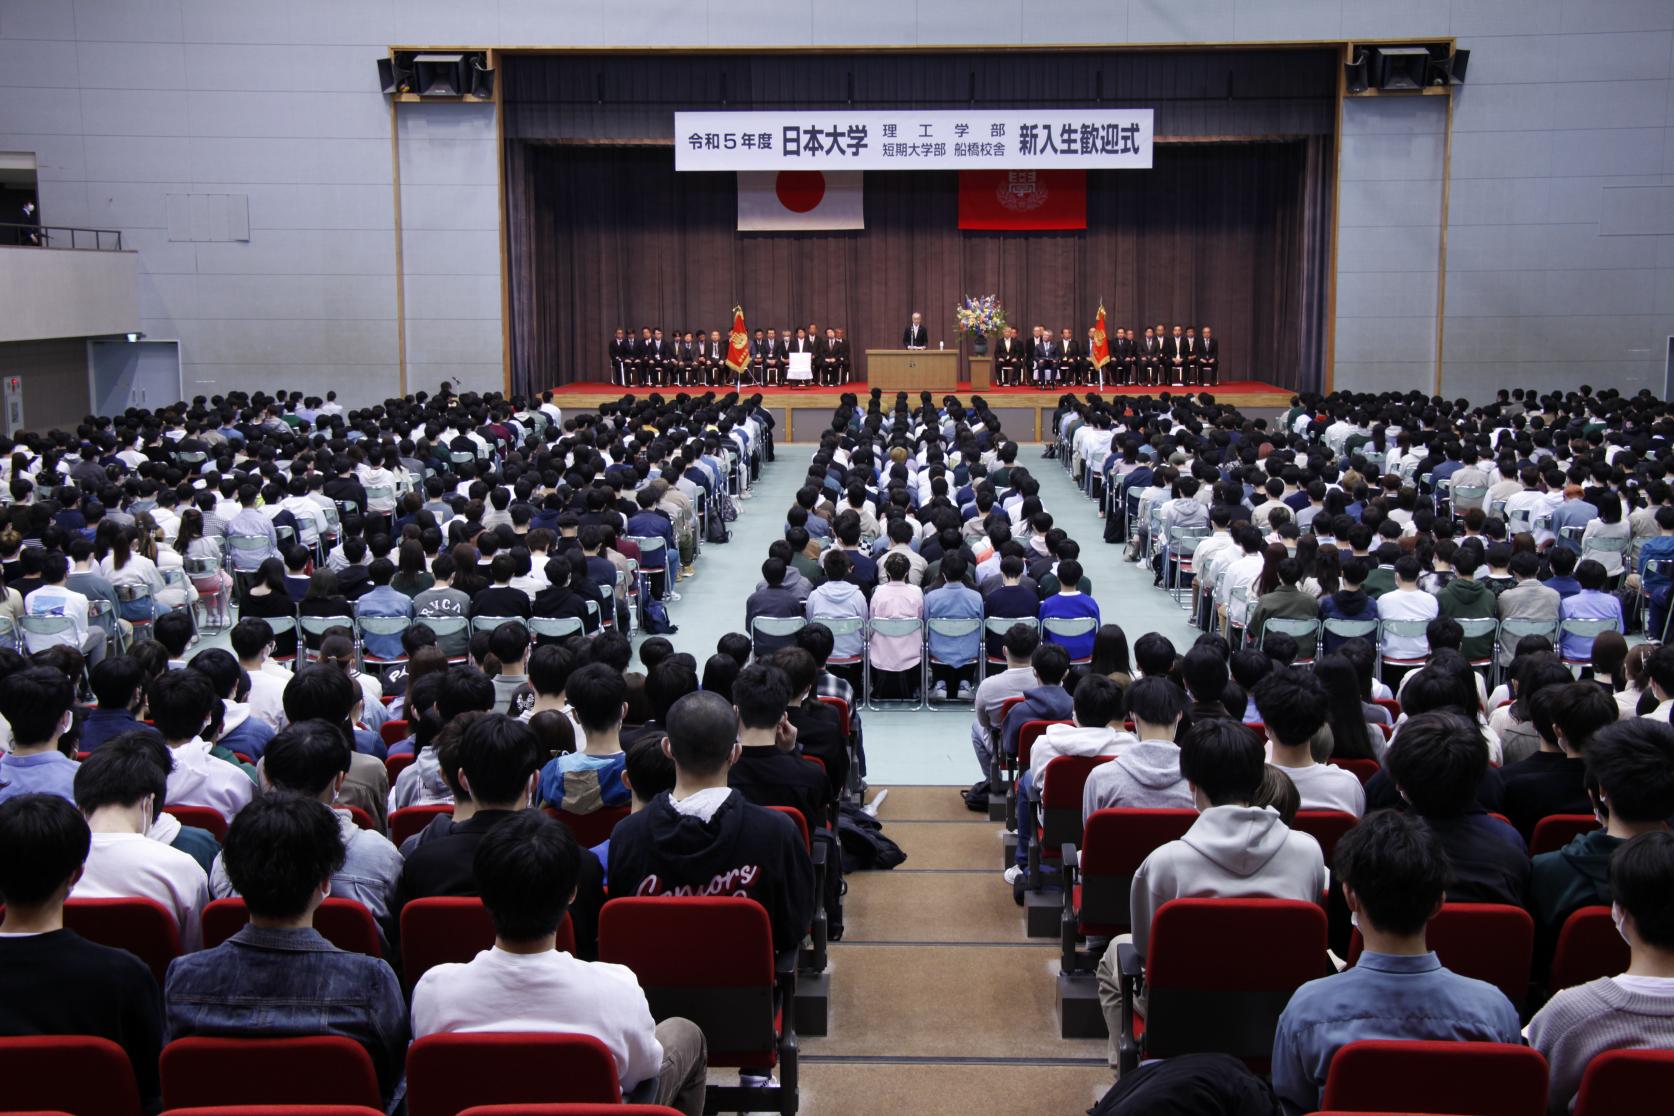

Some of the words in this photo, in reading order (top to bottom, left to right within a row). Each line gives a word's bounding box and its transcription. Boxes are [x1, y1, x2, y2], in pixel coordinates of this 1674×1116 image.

[882, 122, 1006, 138] 理工学部
[688, 132, 773, 150] 令和5年度
[782, 124, 869, 157] 日本大学
[1018, 122, 1141, 156] 新入生歓迎式
[882, 142, 946, 157] 短期大学部
[954, 142, 1006, 157] 船橋校舎
